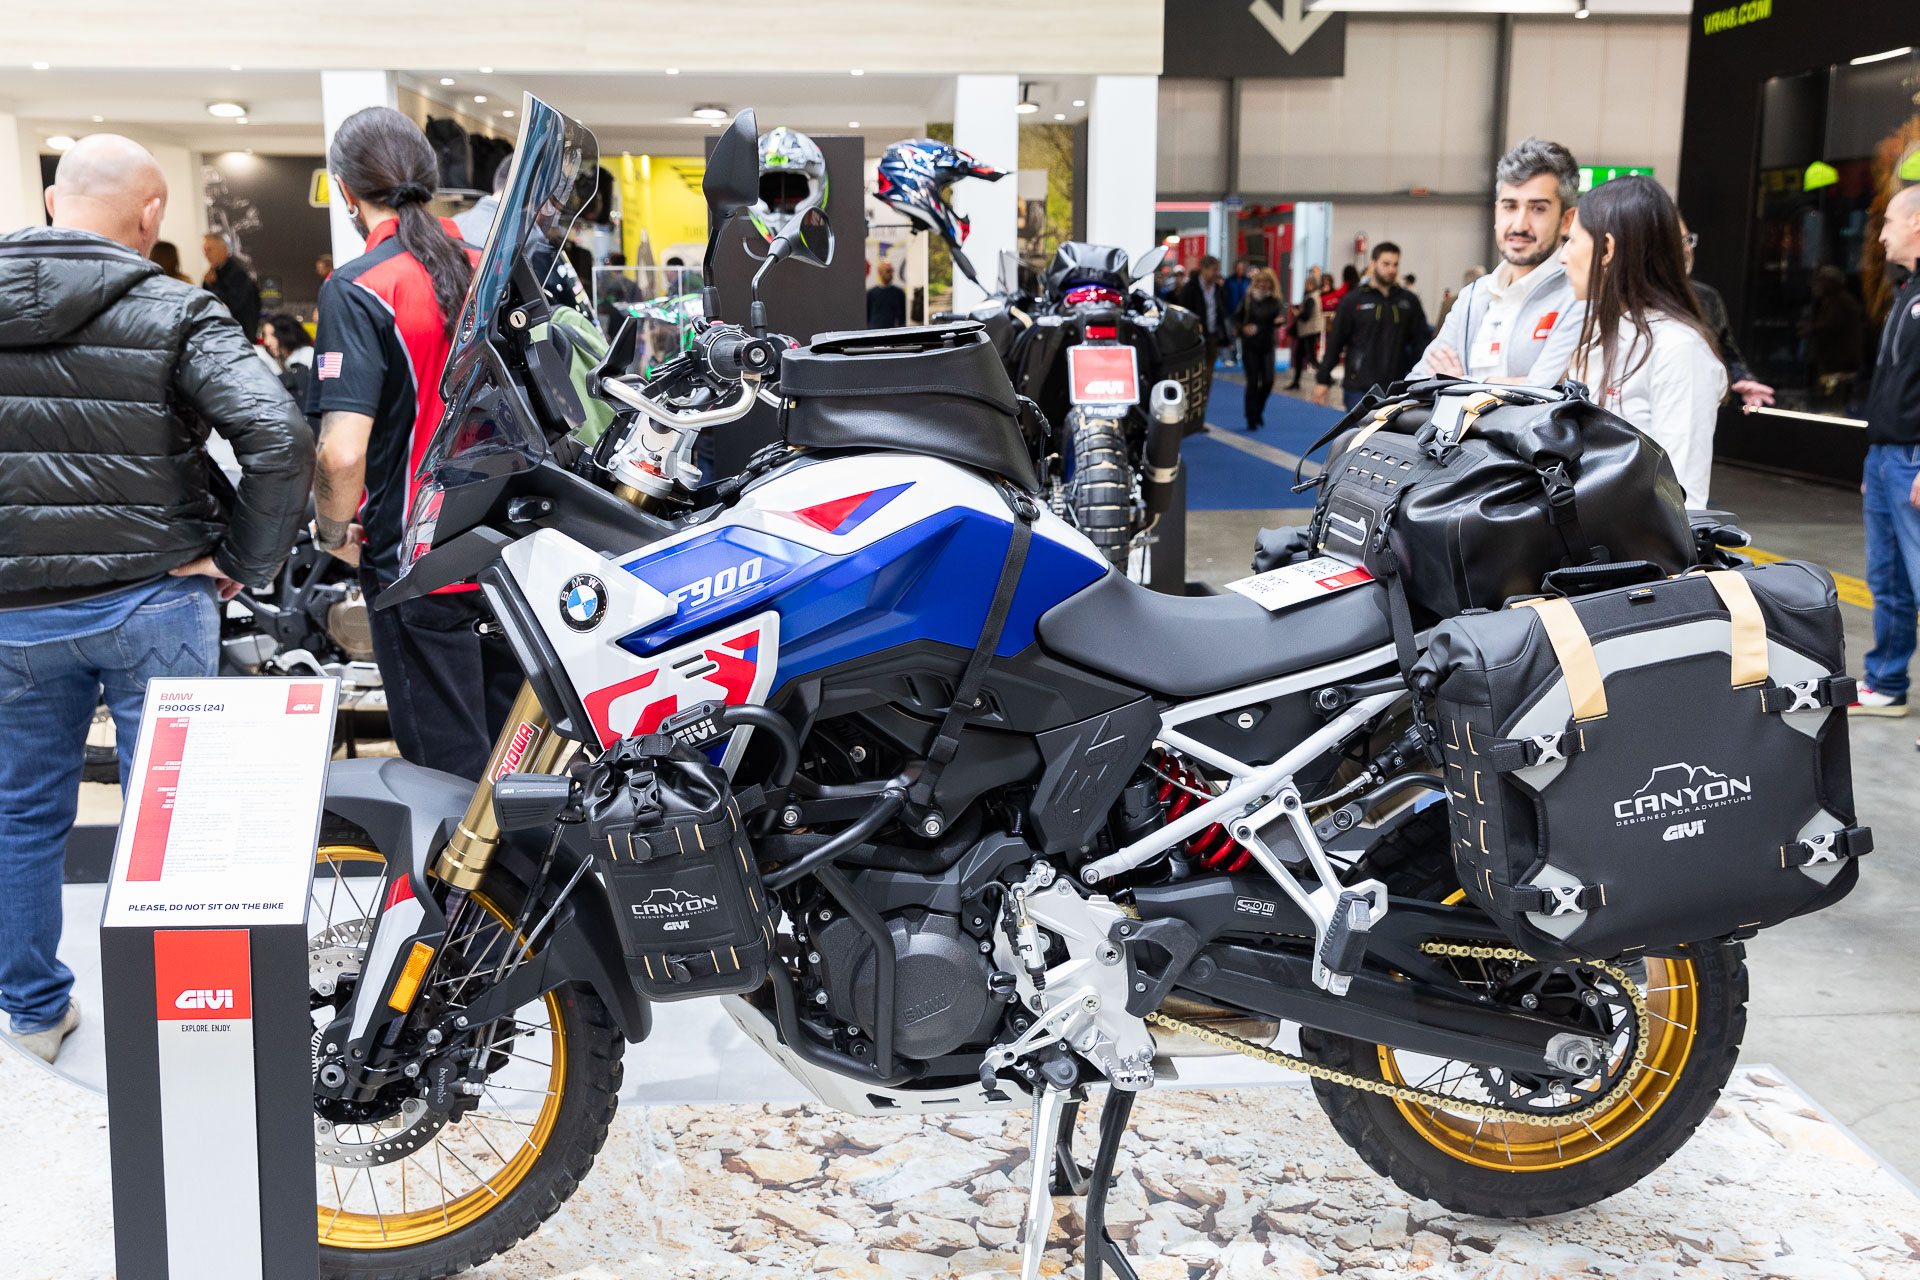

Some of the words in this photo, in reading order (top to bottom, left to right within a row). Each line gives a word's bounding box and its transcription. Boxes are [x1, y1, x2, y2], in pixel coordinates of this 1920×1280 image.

[667, 556, 763, 608] F900
[160, 692, 194, 701] BMW
[158, 704, 202, 712] F900GS
[203, 703, 225, 713] (24)
[1613, 775, 1752, 819] CANYON
[1616, 812, 1667, 827] DESIGNED
[1671, 807, 1691, 816] FOR
[1694, 794, 1753, 812] ADVENTURE
[1662, 819, 1707, 842] GIVI
[128, 904, 167, 912] PLEASE,
[169, 903, 183, 911] DO
[185, 903, 206, 911] NOT
[241, 902, 261, 910] THE
[262, 902, 284, 910] BIKE
[631, 894, 718, 915] CANYON
[681, 906, 719, 917] ADVENTURE
[663, 920, 690, 931] GIVI
[174, 989, 234, 1010] GIVI
[181, 1024, 210, 1032] EXPLORE.
[211, 1024, 232, 1032] ENJOY.
[437, 1067, 448, 1104] brembo
